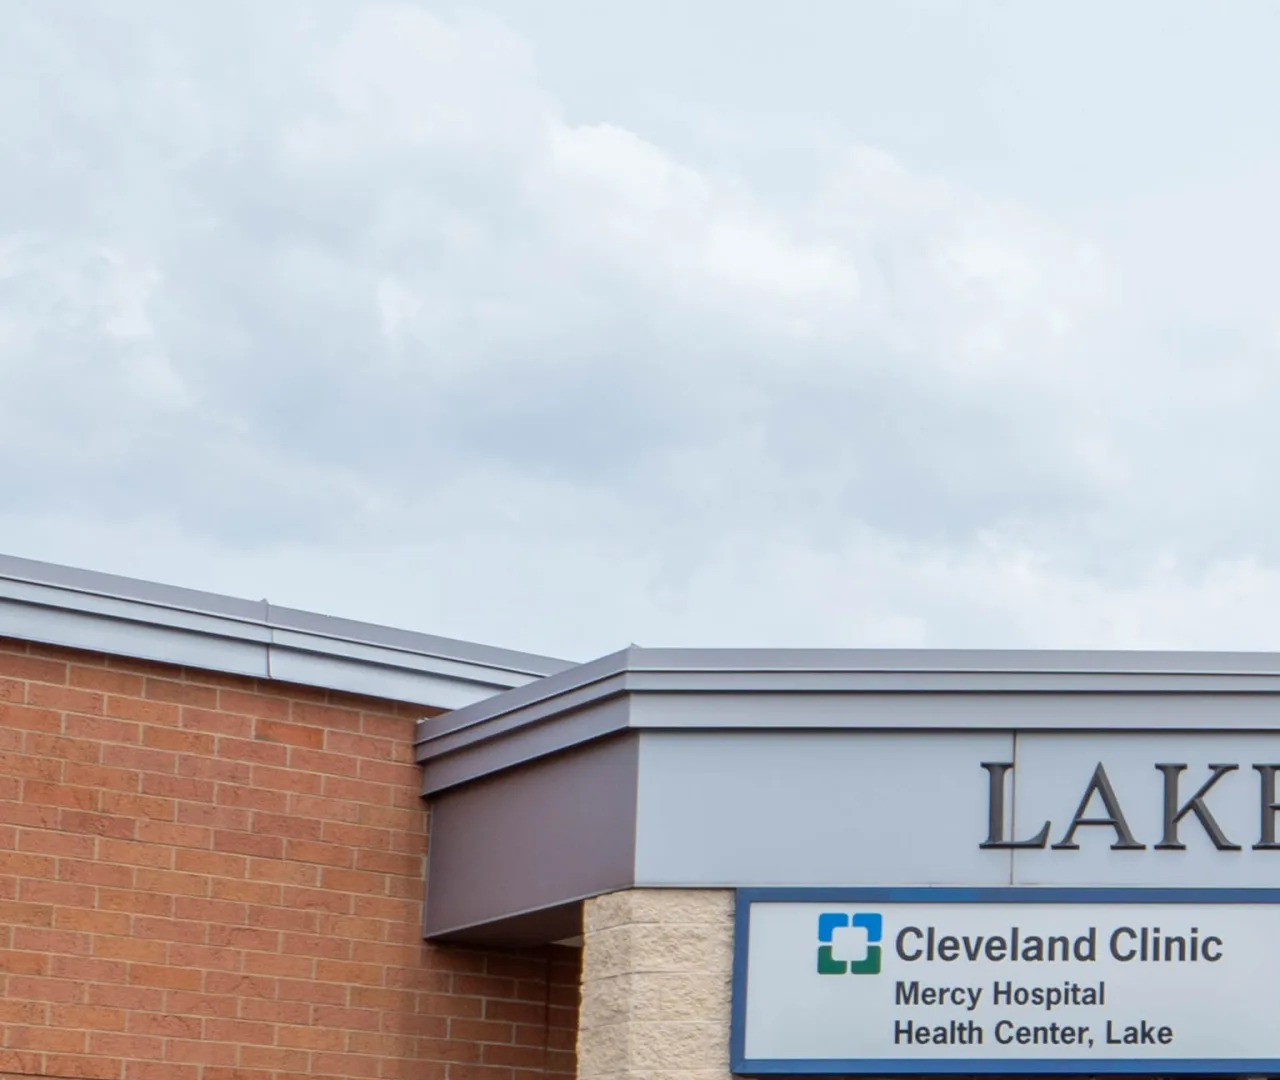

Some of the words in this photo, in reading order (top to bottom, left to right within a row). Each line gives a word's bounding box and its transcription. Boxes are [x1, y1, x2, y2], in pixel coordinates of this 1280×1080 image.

[895, 926, 1097, 963] Cleveland
[1109, 926, 1224, 963] Clinic
[894, 980, 983, 1011] Mercy
[992, 980, 1106, 1011] Hospital
[893, 1019, 984, 1045] Health
[994, 1019, 1095, 1048] Center,
[1106, 1019, 1174, 1045] Lake
